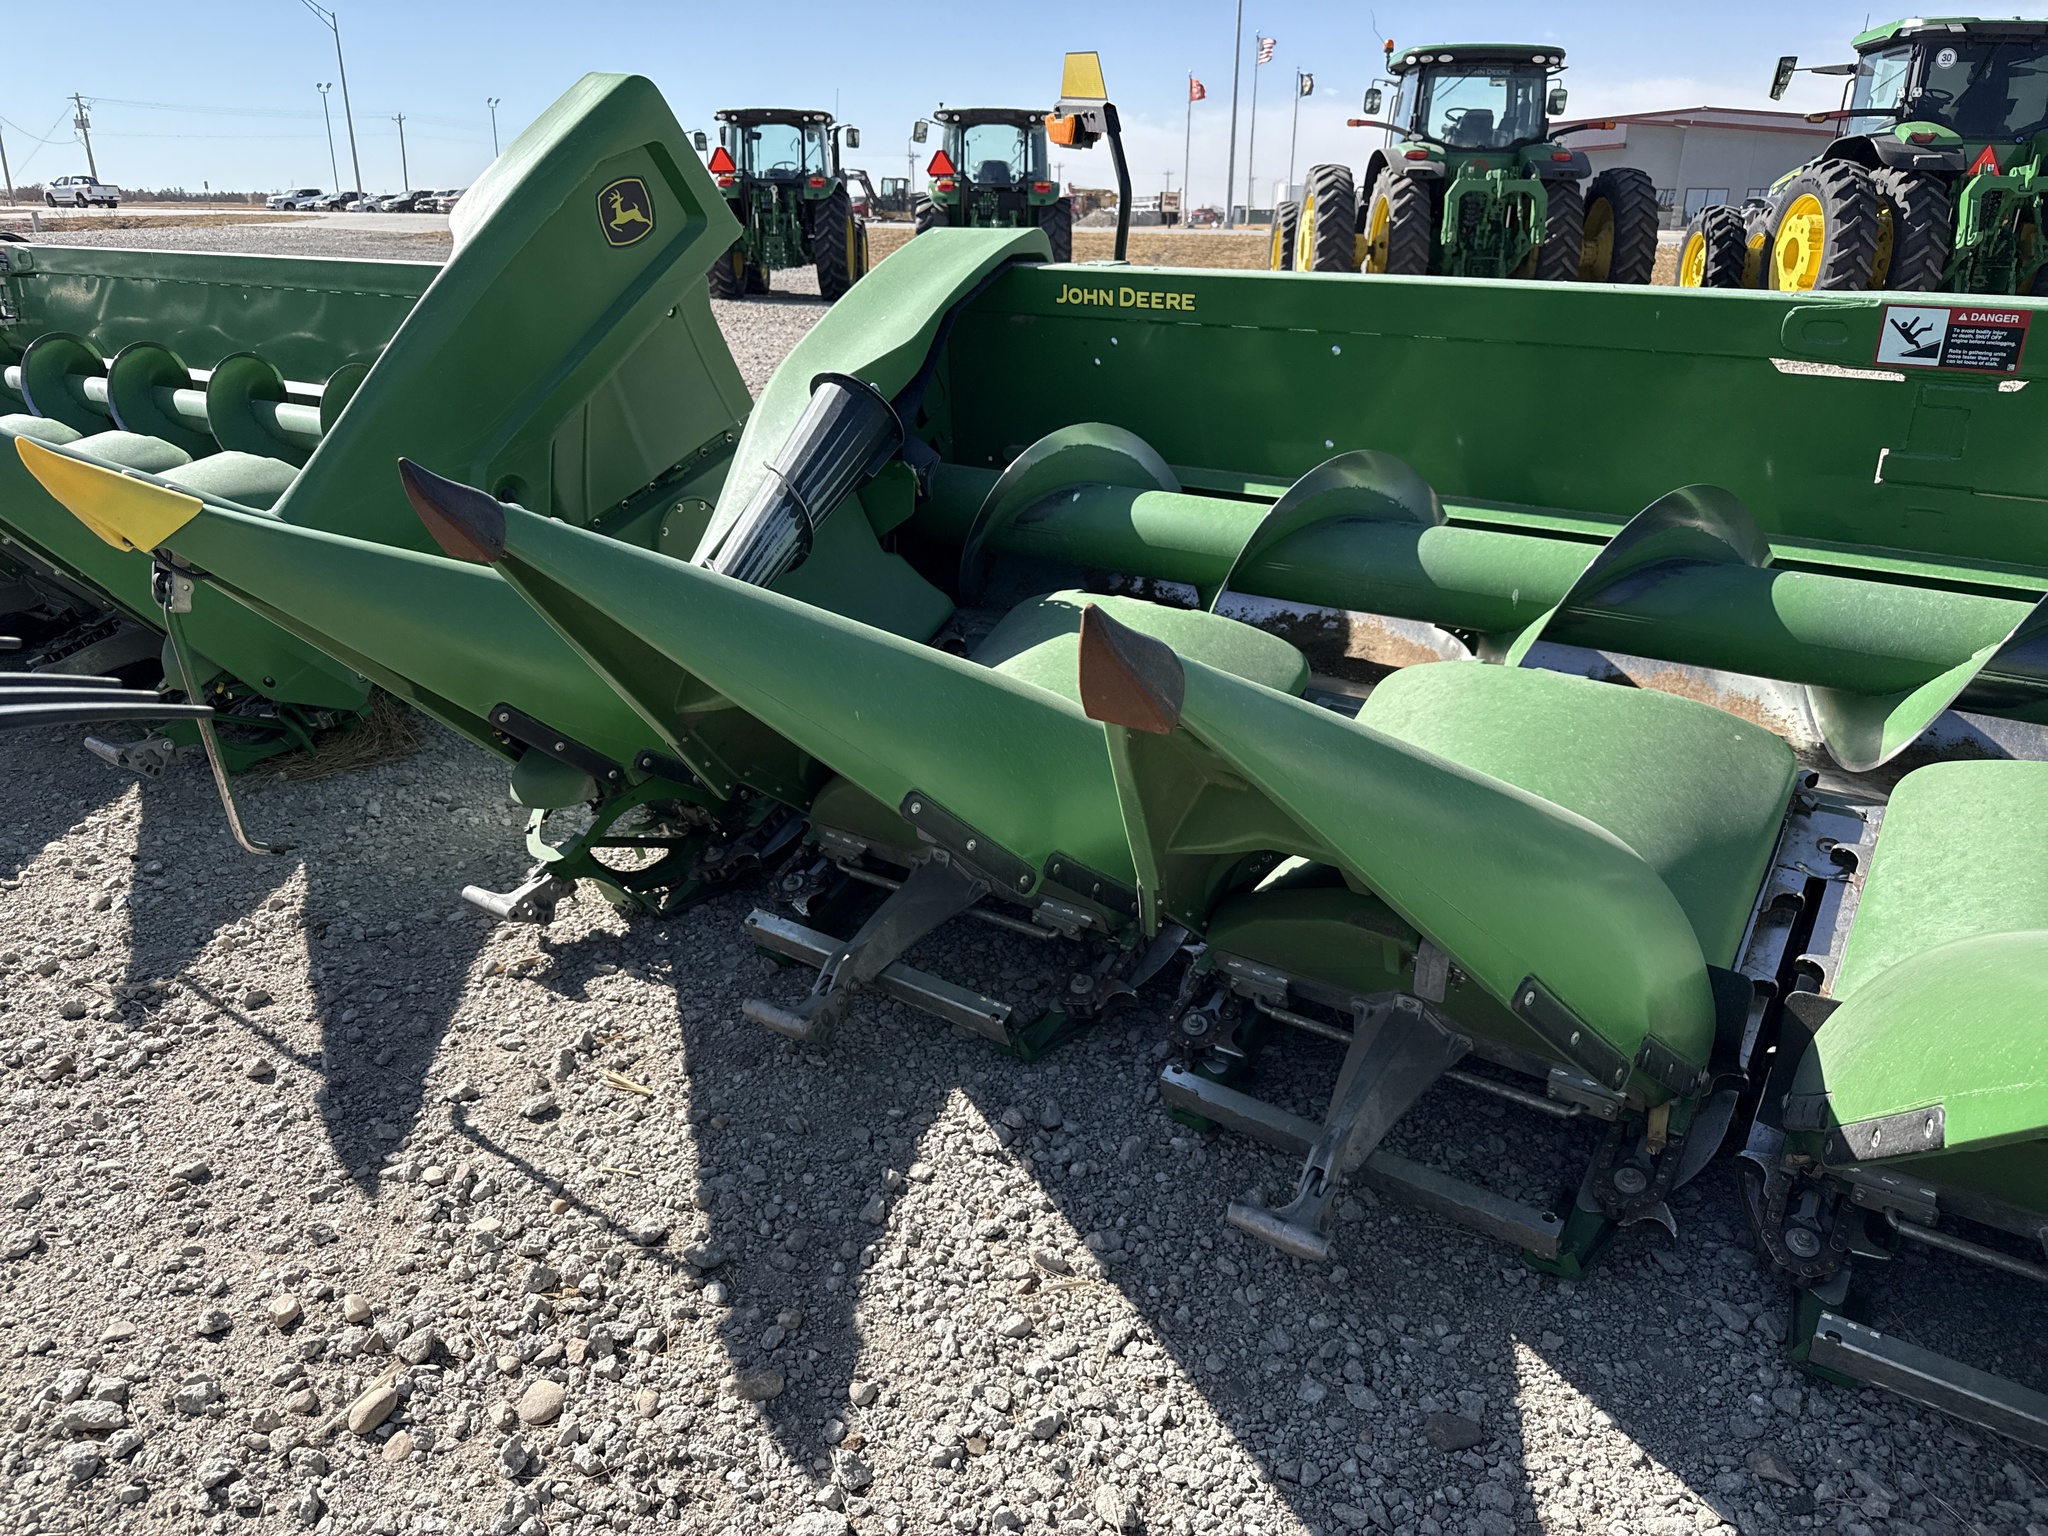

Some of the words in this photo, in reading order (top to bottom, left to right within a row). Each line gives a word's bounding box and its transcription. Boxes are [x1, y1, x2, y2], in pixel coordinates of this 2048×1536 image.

[1941, 53, 1952, 62] 30
[1486, 68, 1511, 76] DEERE
[1056, 284, 1114, 306] JOHN
[1119, 286, 1196, 311] DEERE
[1970, 313, 2020, 323] DANGER
[1986, 340, 2017, 348] unclogging.
[1968, 349, 1993, 357] gathering
